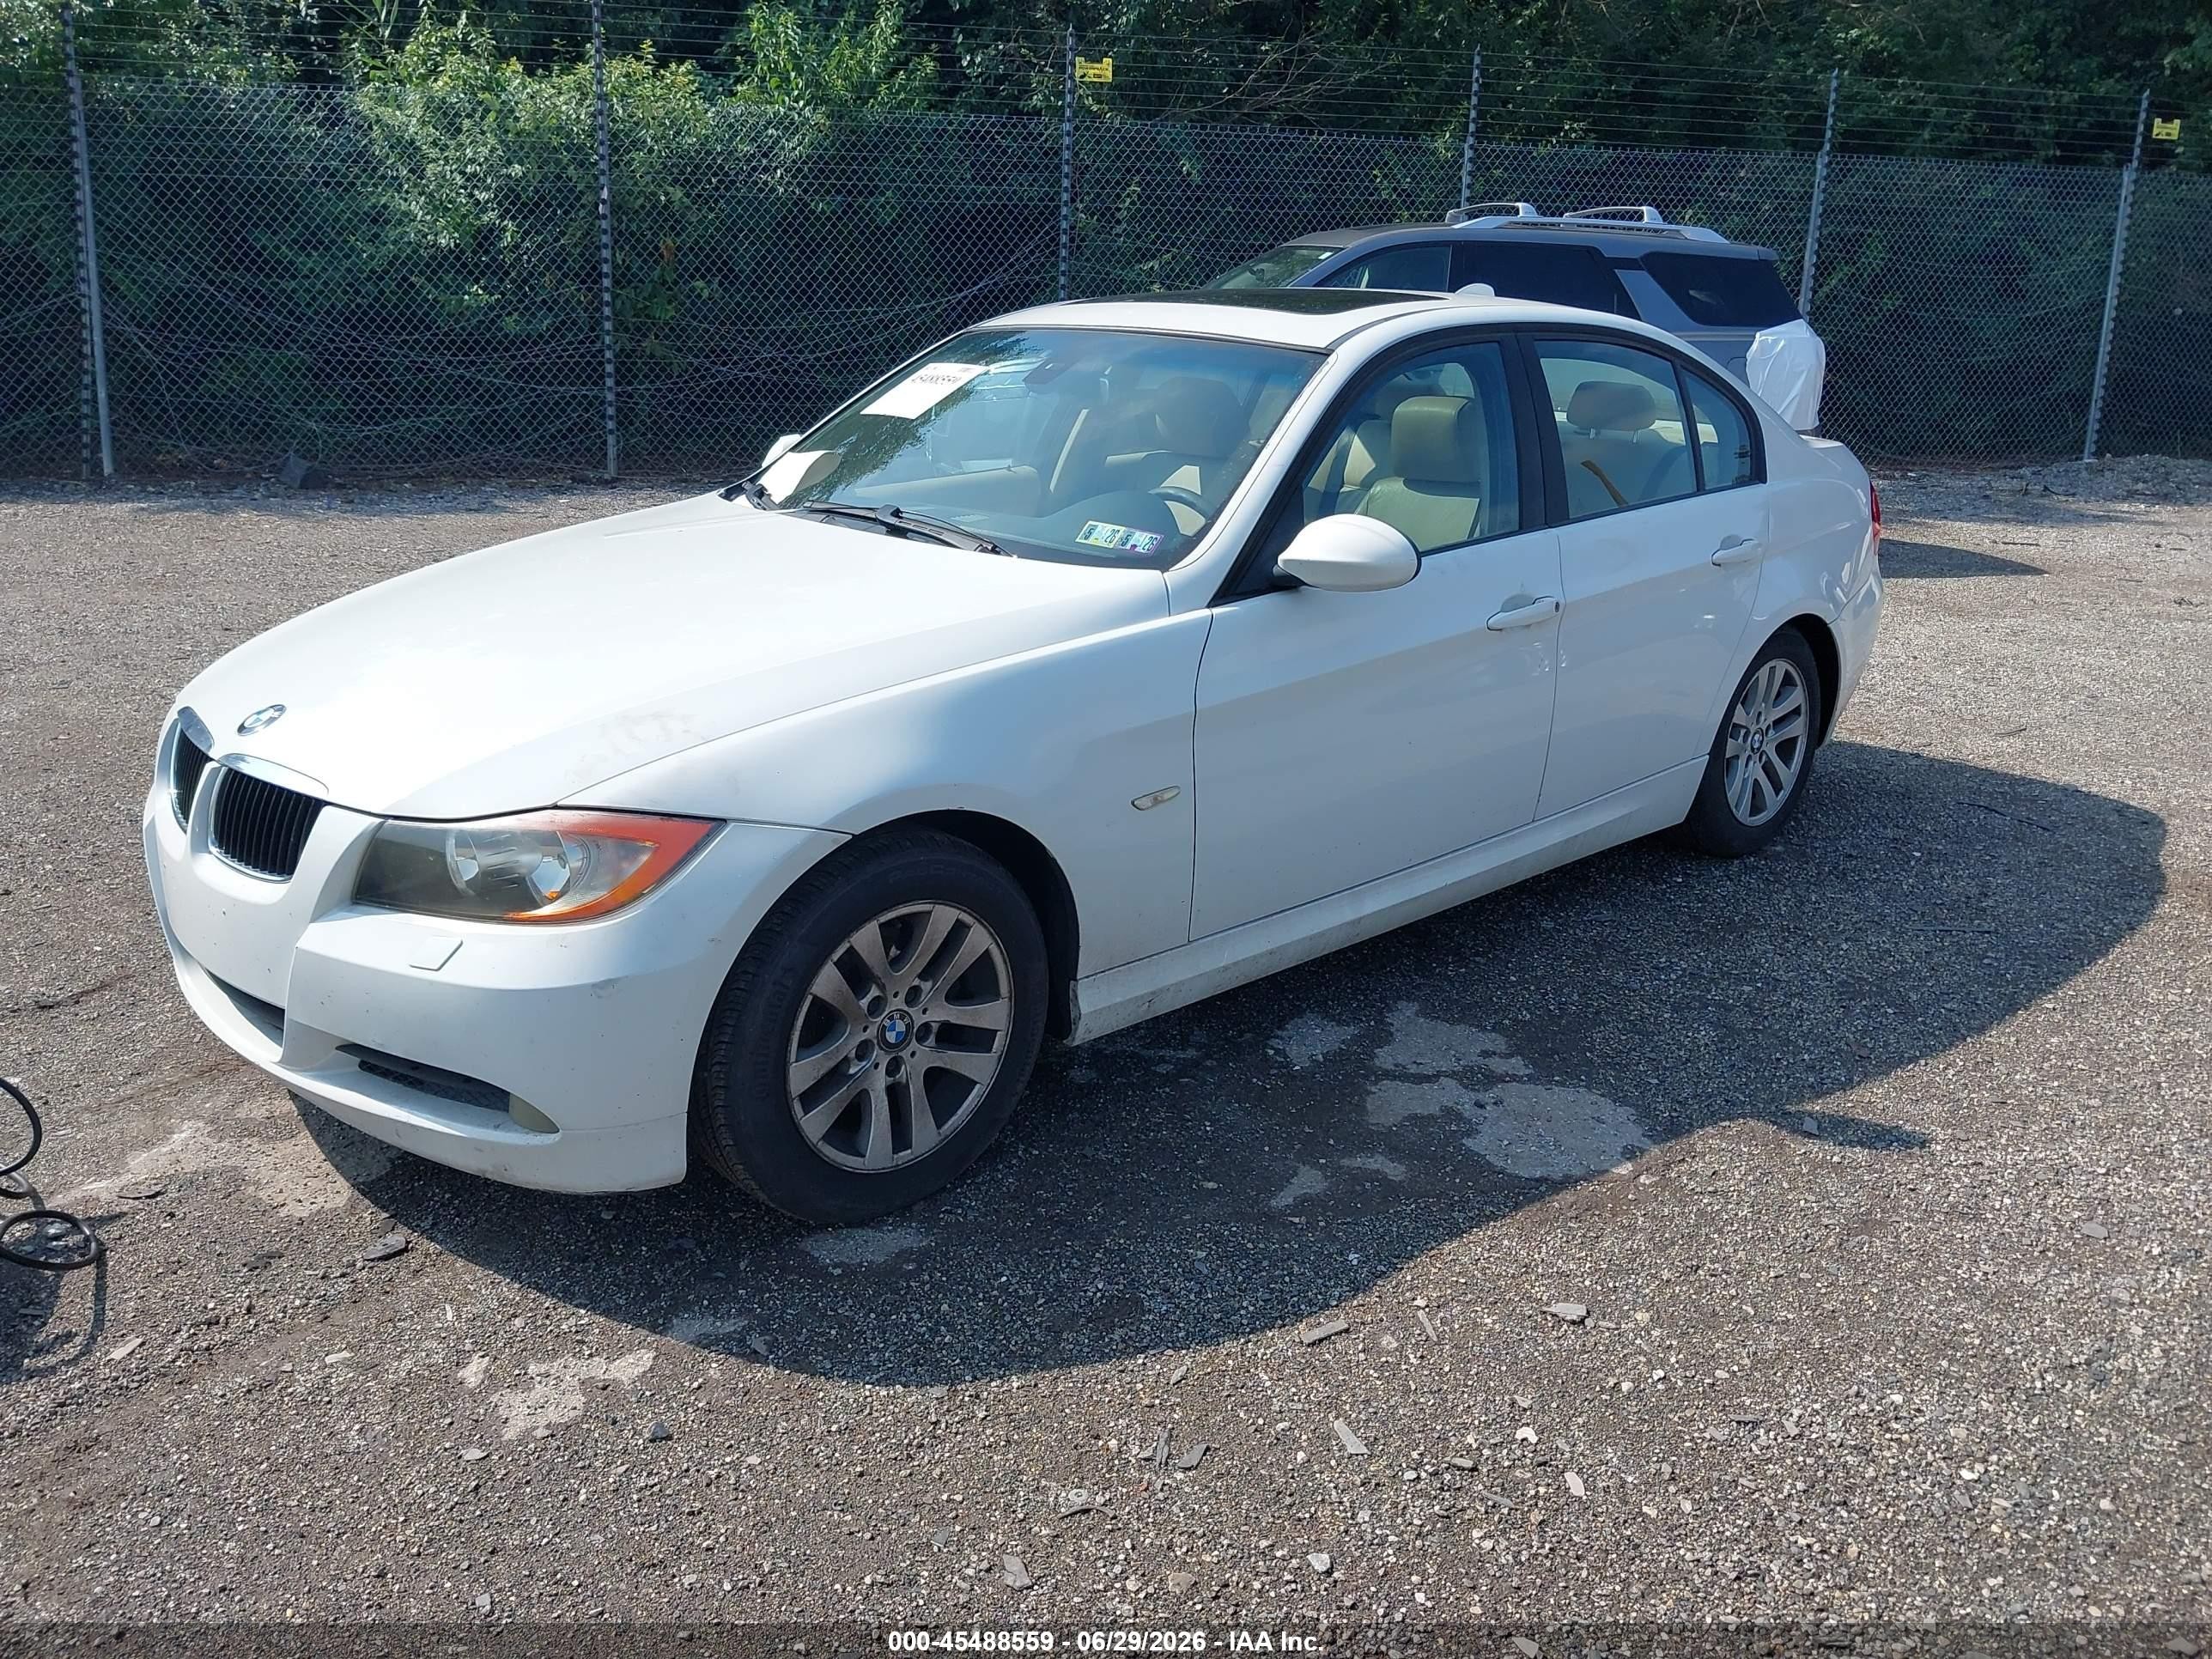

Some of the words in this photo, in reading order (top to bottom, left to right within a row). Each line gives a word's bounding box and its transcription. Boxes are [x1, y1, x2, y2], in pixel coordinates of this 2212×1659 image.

[1084, 527, 1096, 540] 5
[1104, 528, 1120, 544] 26
[1121, 534, 1132, 547] 5
[1142, 536, 1158, 550] 26
[884, 1013, 910, 1026] BMW
